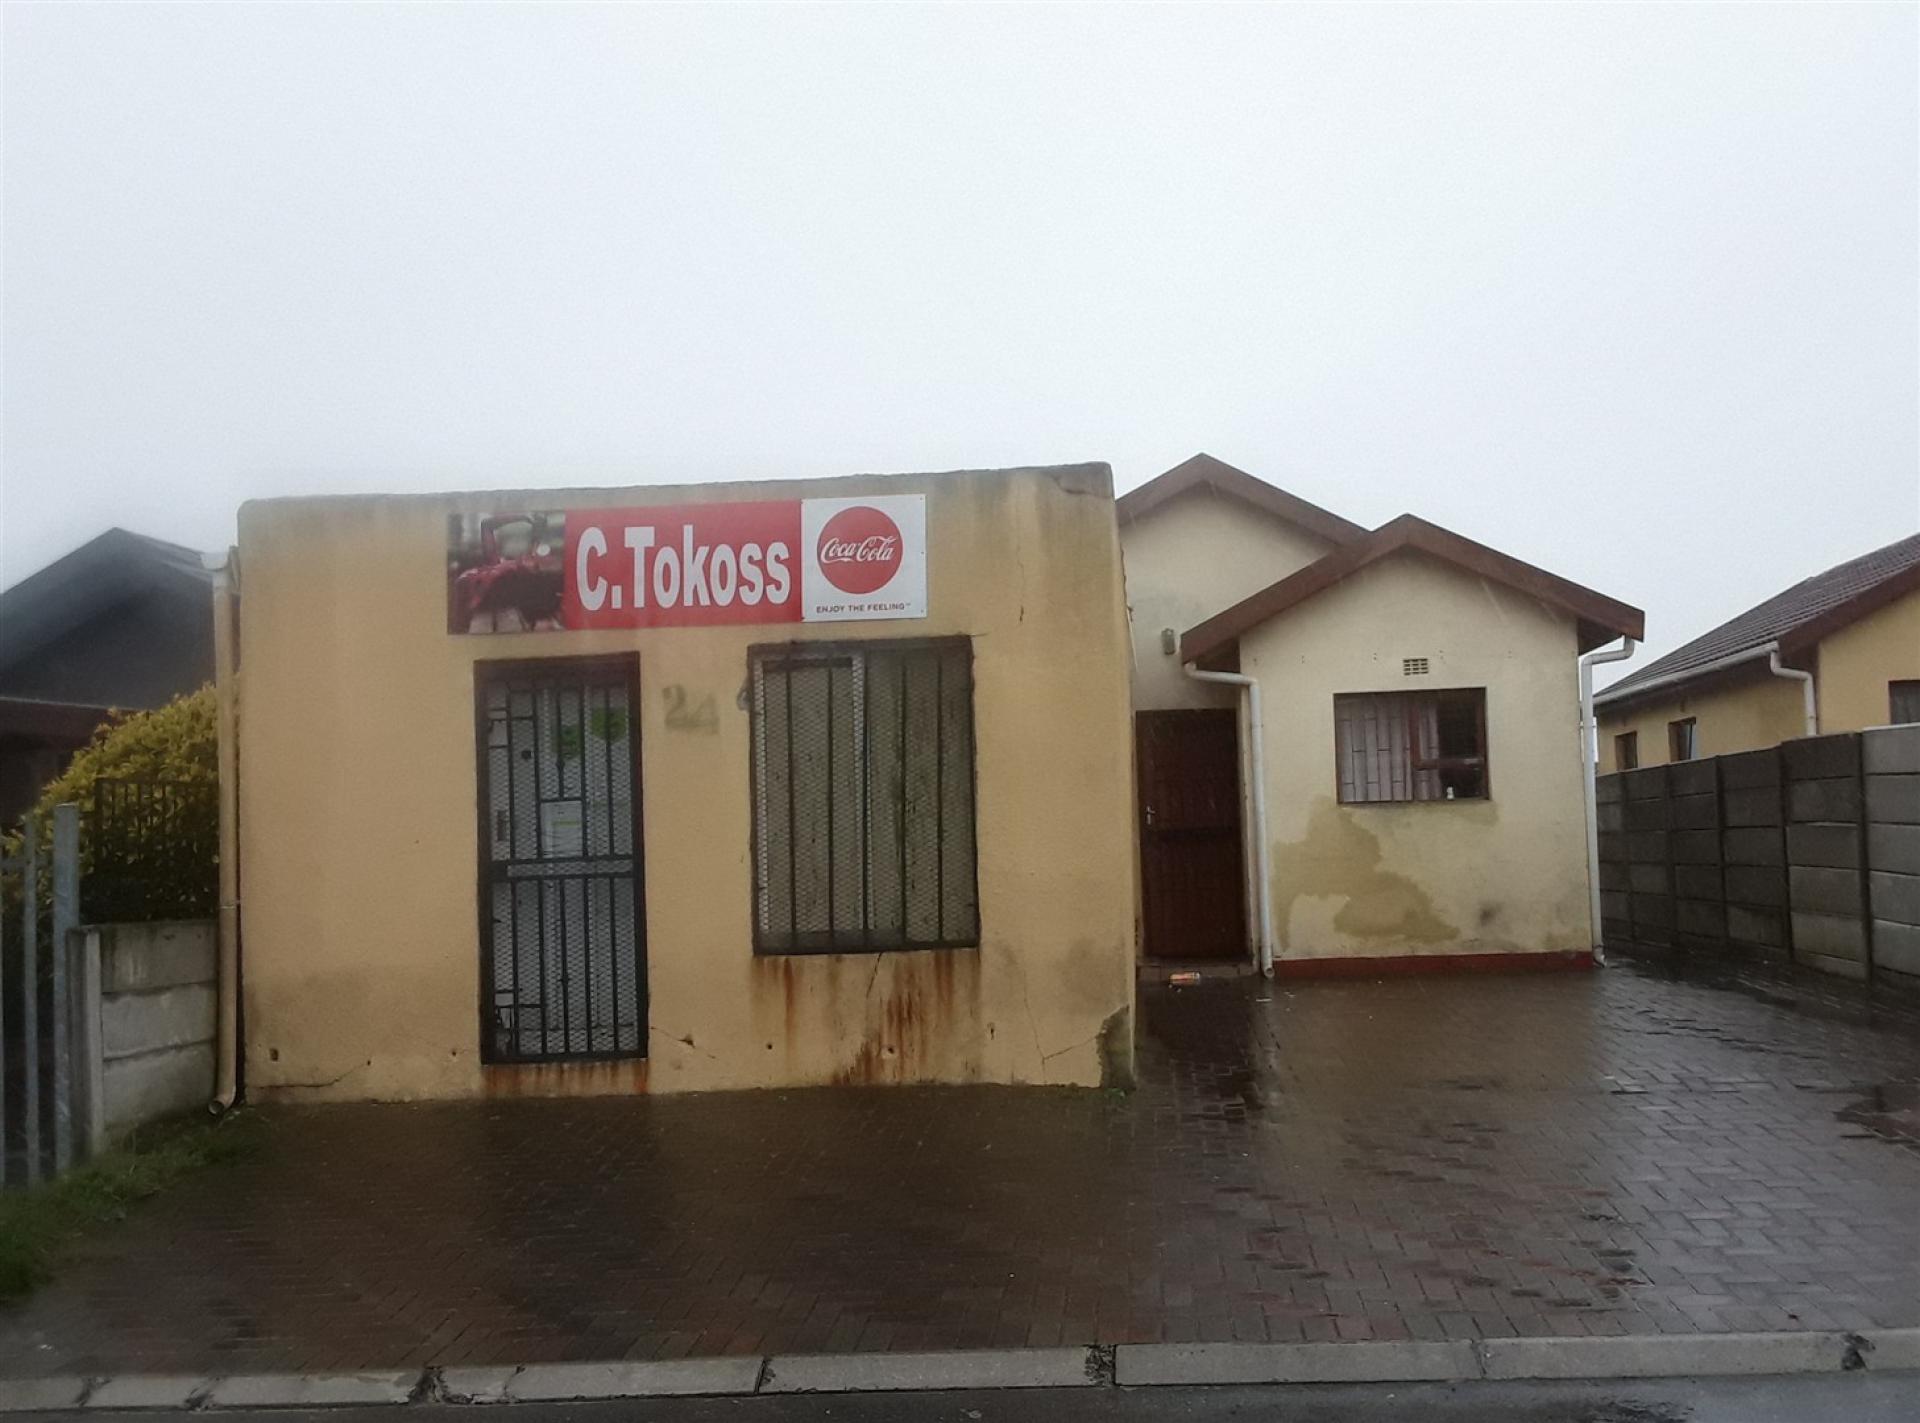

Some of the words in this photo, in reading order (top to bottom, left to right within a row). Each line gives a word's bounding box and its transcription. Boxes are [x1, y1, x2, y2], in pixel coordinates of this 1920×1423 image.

[820, 535, 897, 564] Coca-Cola
[816, 604, 845, 614] ENJOY
[848, 603, 866, 612] THE
